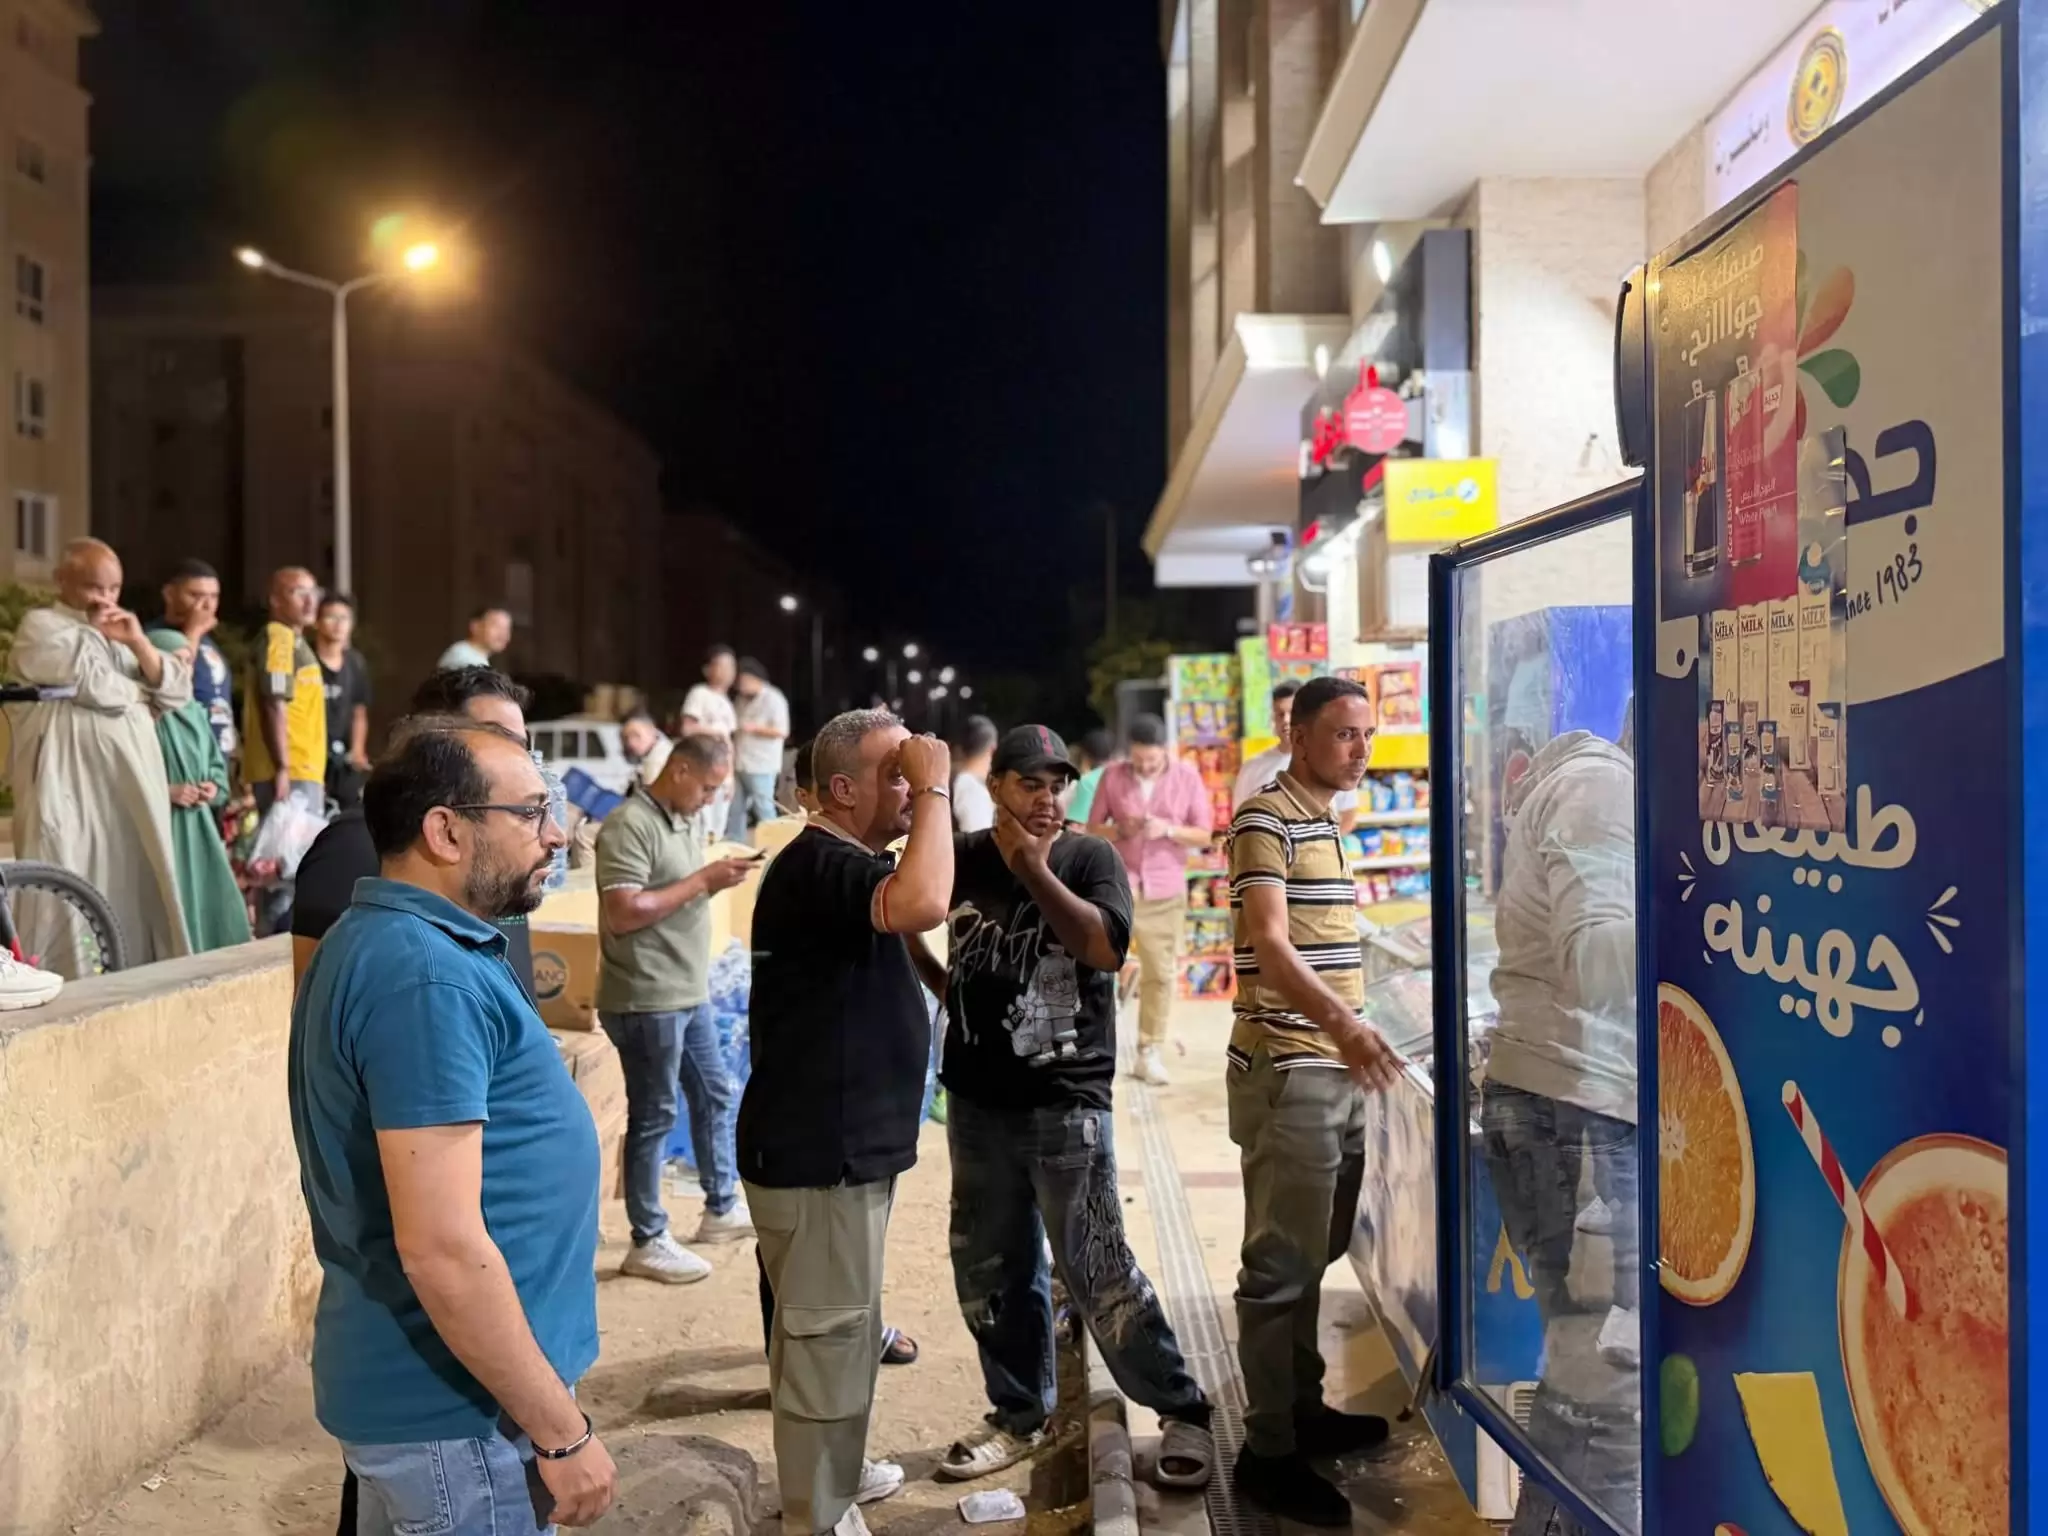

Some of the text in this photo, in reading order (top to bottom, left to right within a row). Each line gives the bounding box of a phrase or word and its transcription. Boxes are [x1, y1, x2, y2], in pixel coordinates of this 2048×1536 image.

[1876, 543, 1923, 605] 1983
[1740, 618, 1764, 633] MILK
[1771, 614, 1794, 628] MILK
[1714, 623, 1734, 639] MILK
